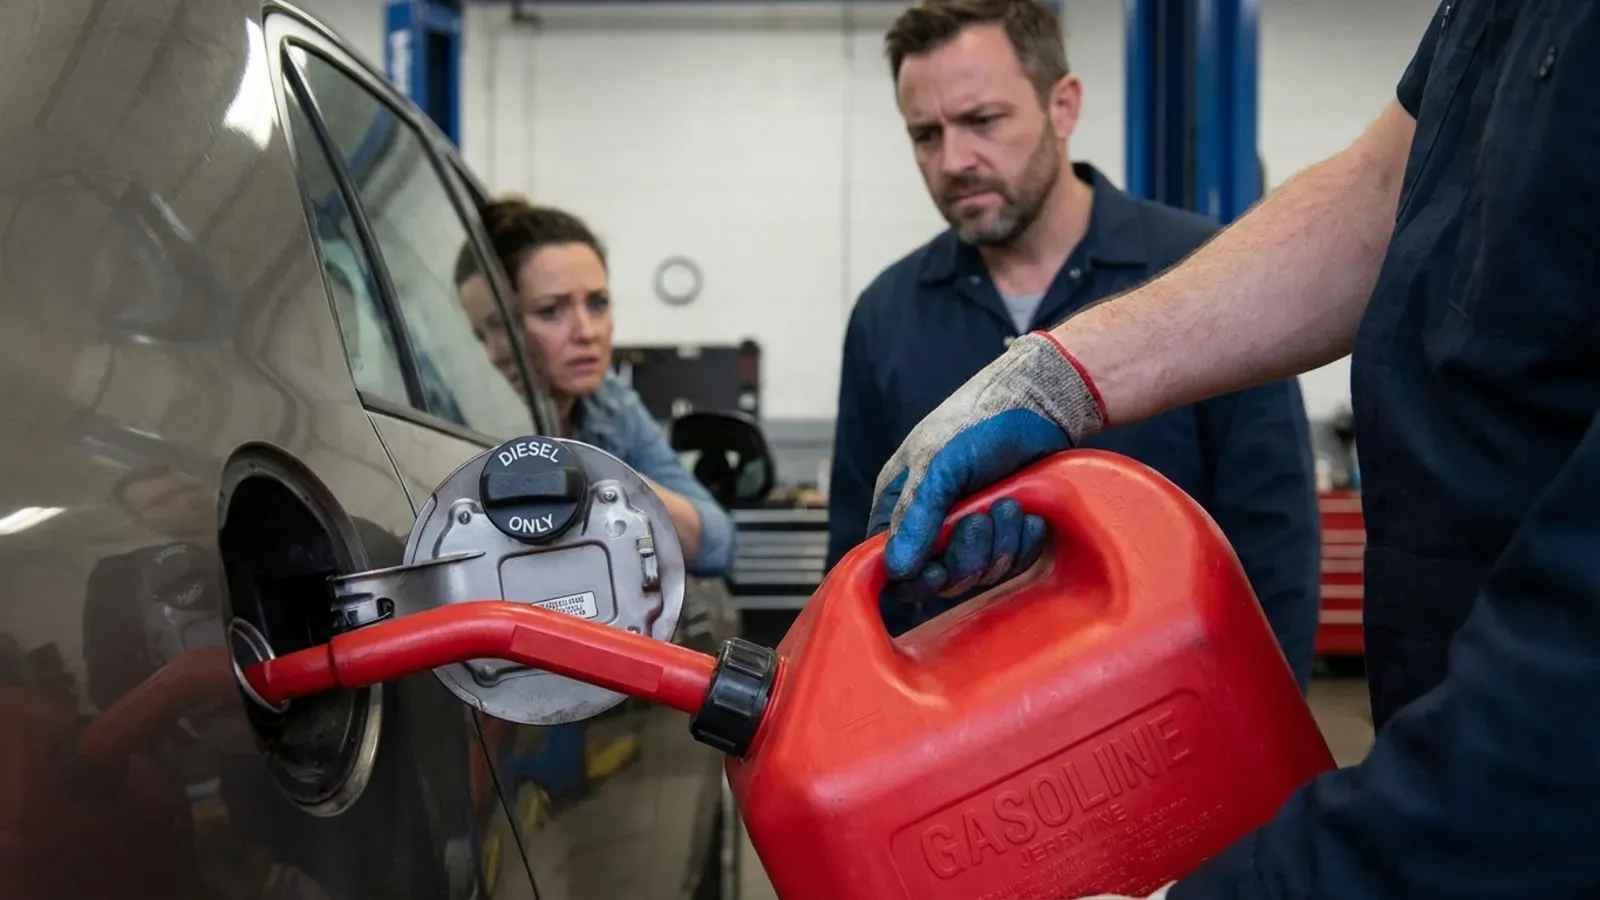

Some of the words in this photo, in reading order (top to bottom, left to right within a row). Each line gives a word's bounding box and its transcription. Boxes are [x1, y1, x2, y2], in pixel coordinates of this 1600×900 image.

[498, 441, 559, 467] DIESEL
[508, 513, 553, 533] ONLY
[921, 710, 1190, 880] GASOLINE
